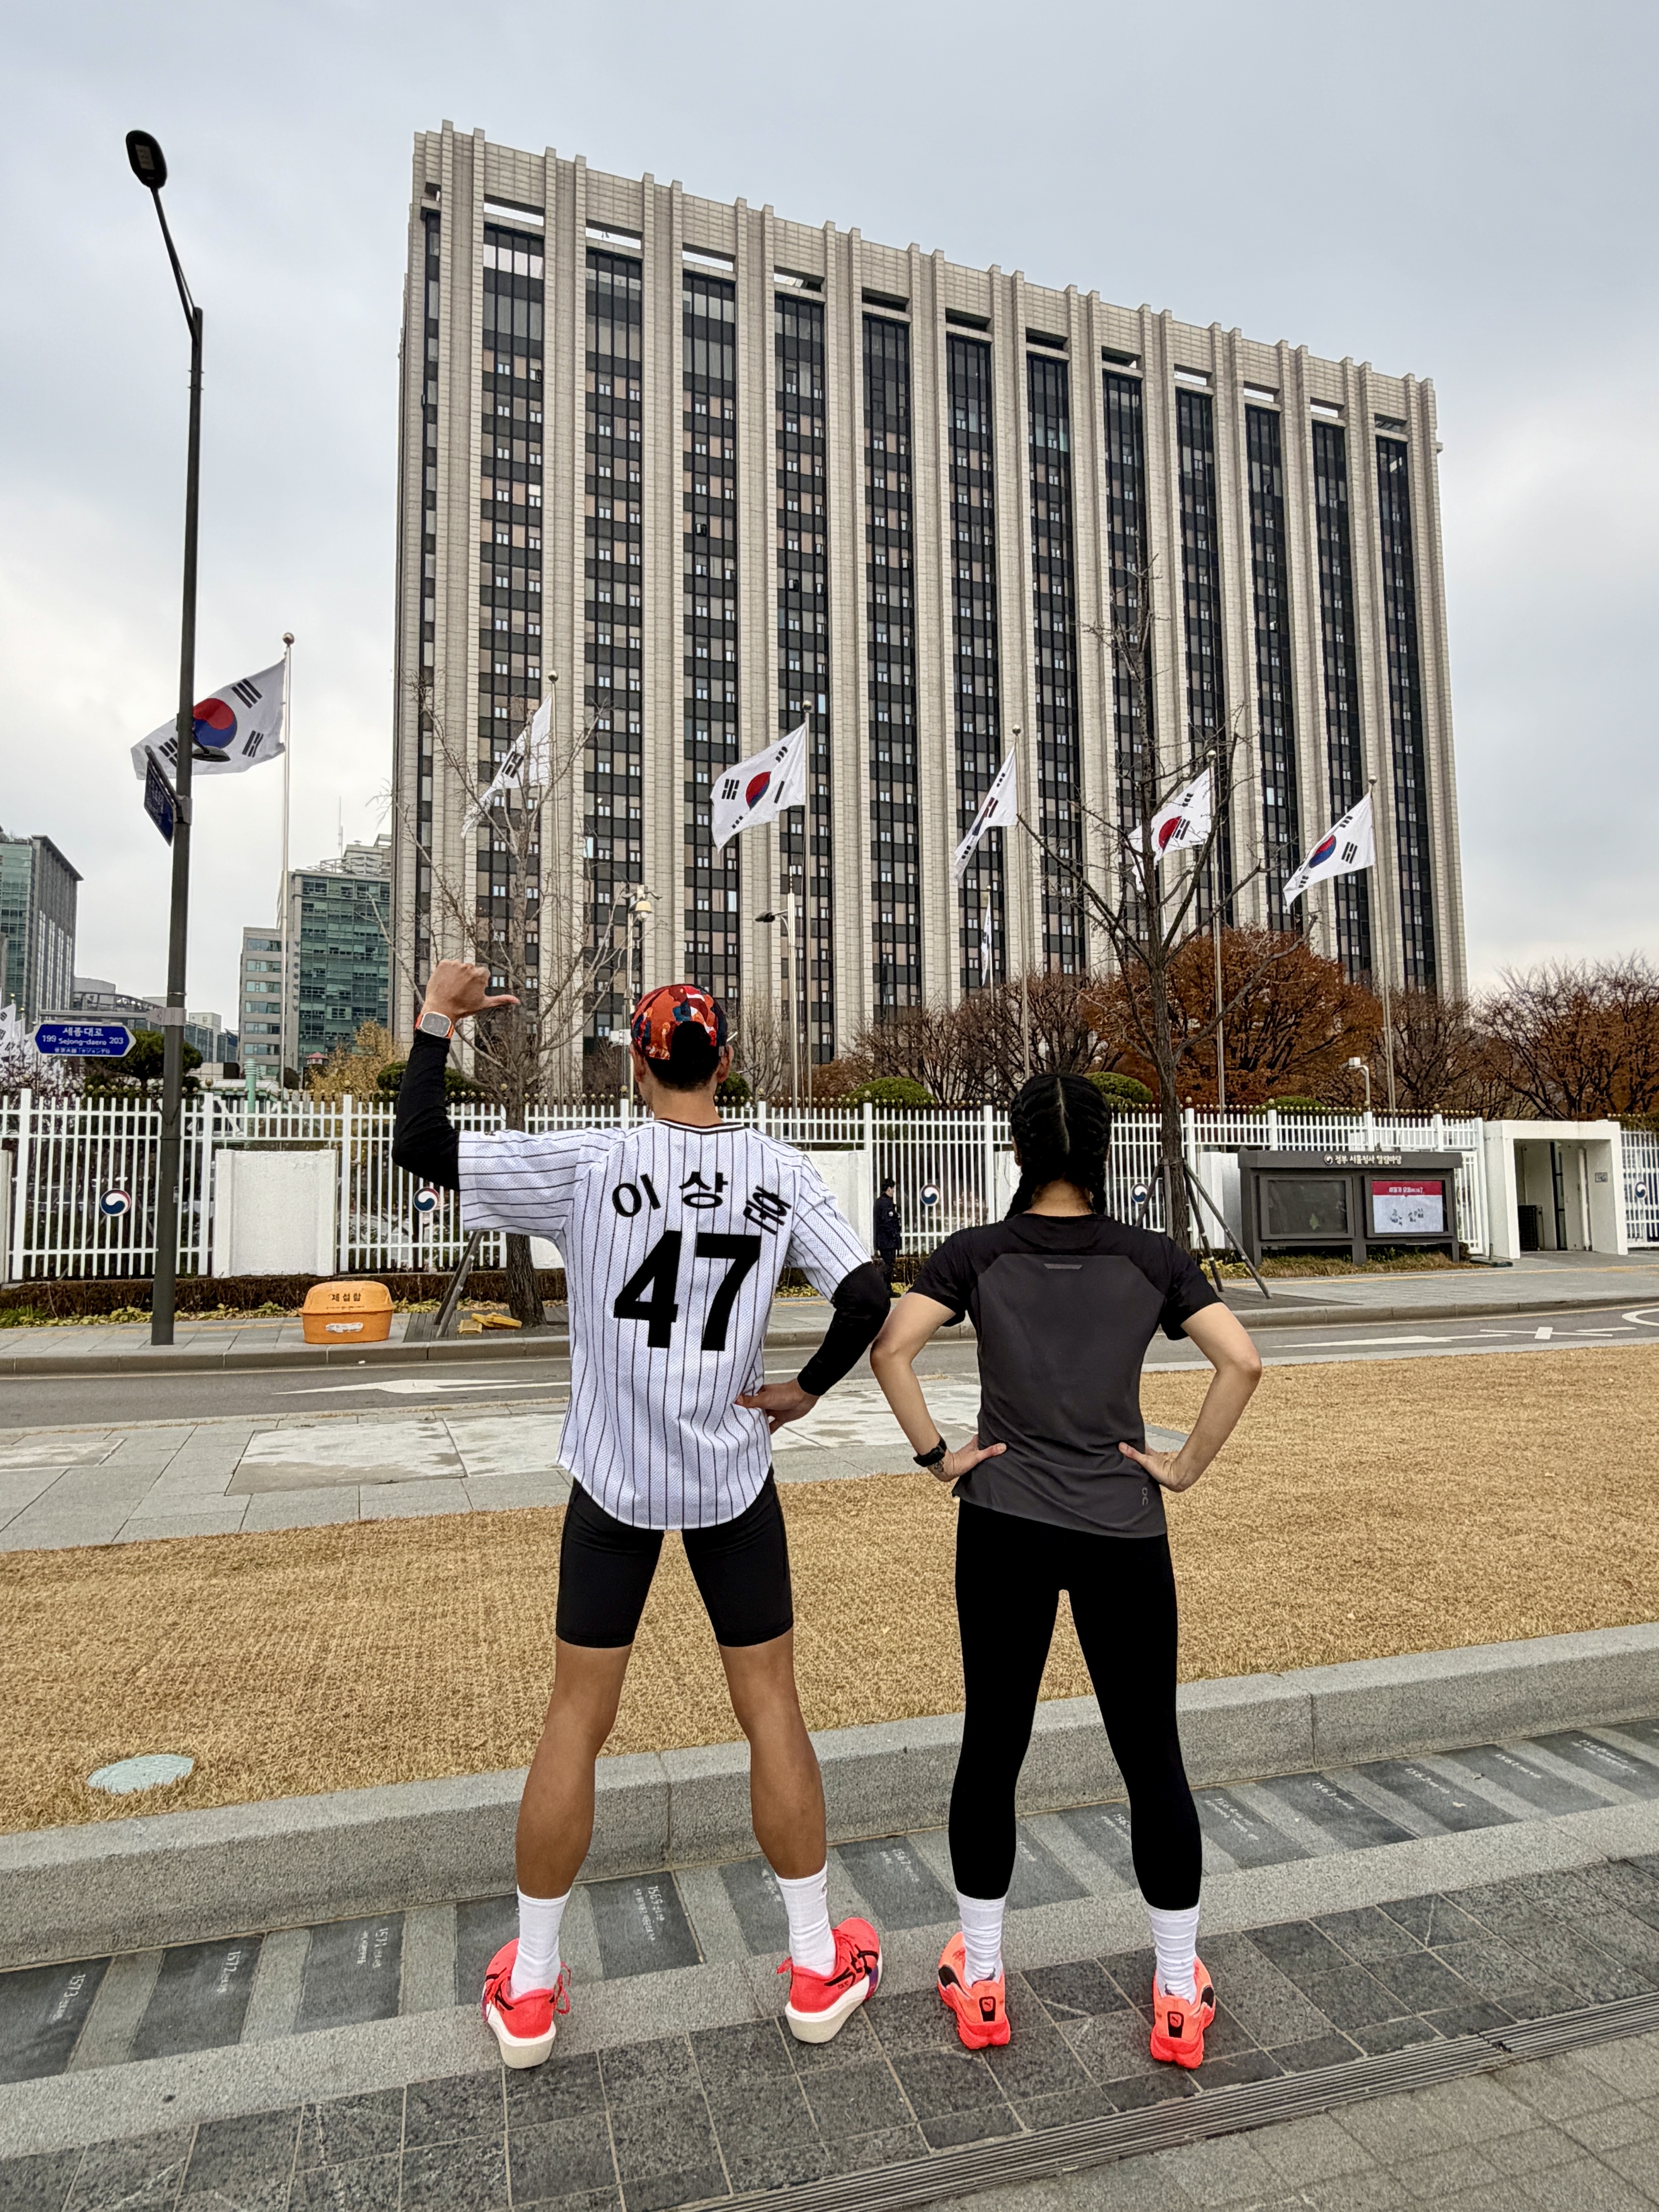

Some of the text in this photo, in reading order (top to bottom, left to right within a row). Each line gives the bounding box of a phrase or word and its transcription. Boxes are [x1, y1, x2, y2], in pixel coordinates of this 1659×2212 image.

[58, 1037, 107, 1046] Sejong-daero
[62, 1027, 104, 1037] 세종대로
[612, 1171, 792, 1235] 이상훈
[613, 1230, 762, 1352] 47
[891, 1848, 912, 1864] 1567
[647, 1885, 663, 1905] 1569
[223, 1951, 241, 1973] 1572
[64, 1974, 86, 1997] 1573
